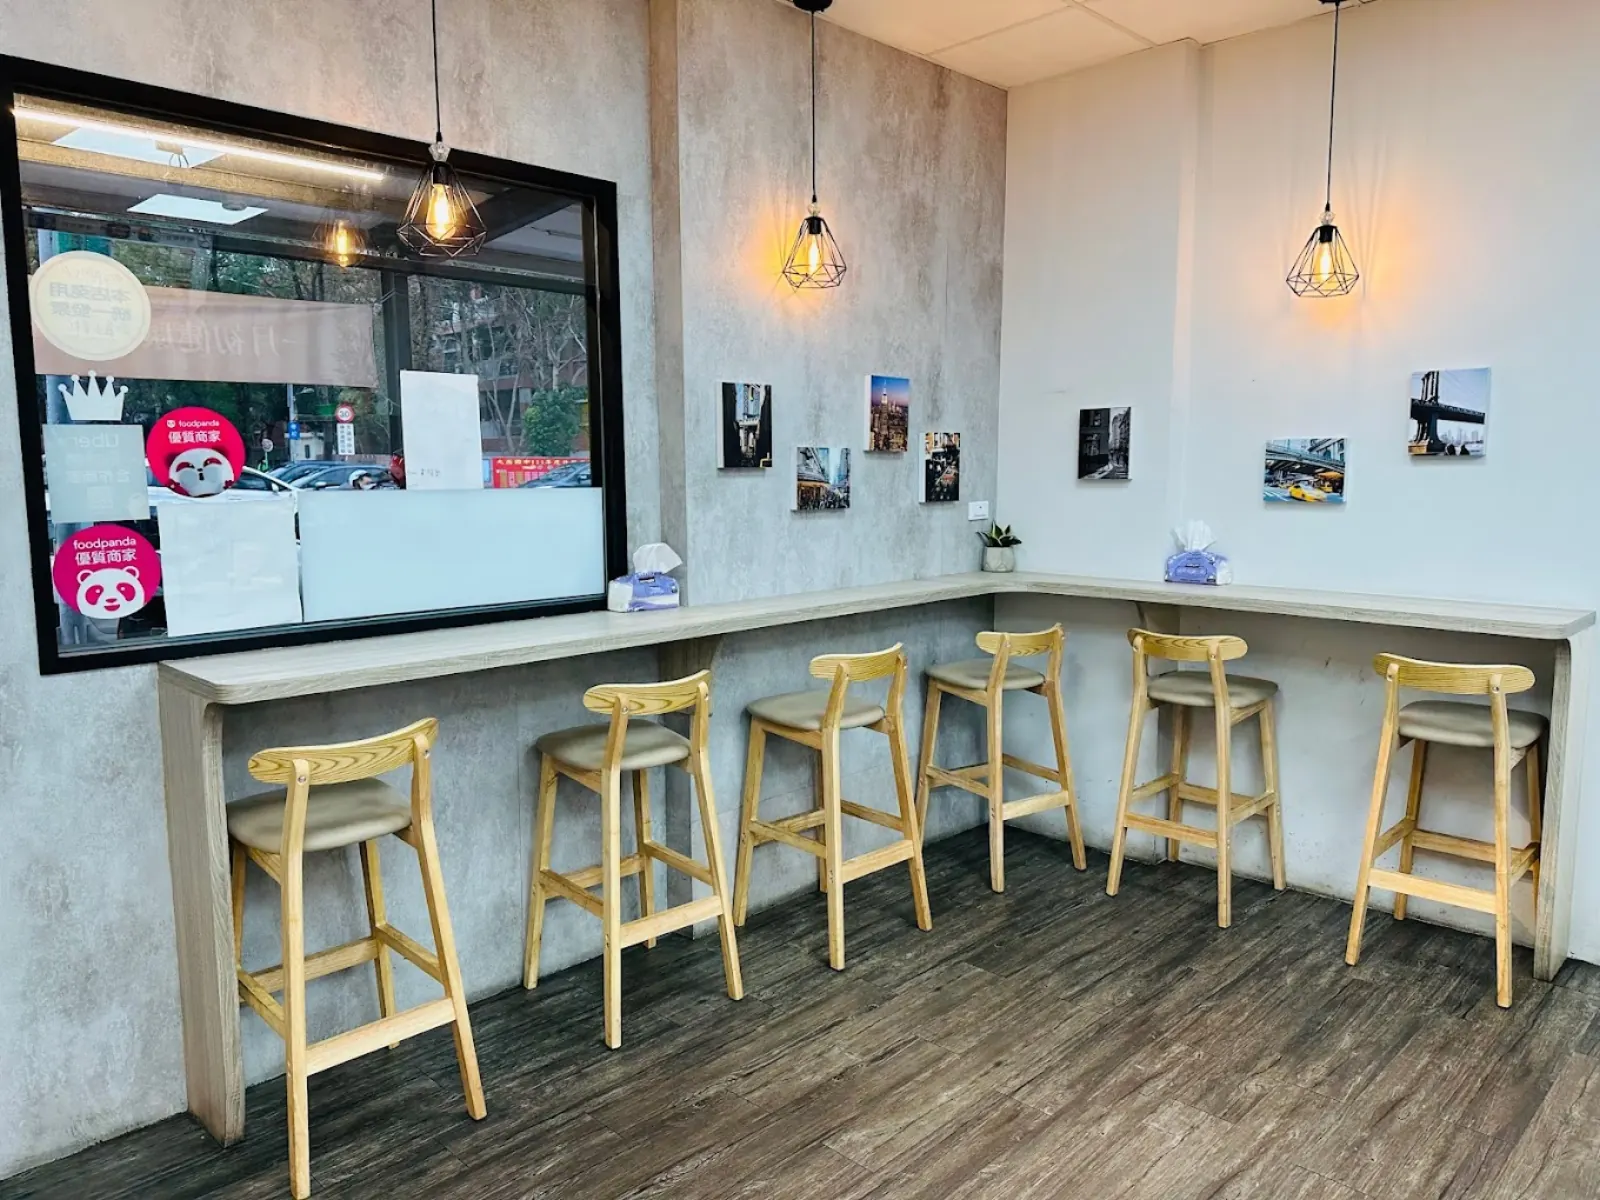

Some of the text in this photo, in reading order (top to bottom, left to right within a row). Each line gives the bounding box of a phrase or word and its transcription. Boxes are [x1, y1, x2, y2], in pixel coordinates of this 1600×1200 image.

[178, 419, 220, 428] foodpanda
[168, 430, 221, 444] 優質商家
[73, 536, 136, 550] foodpanda
[75, 548, 137, 567] 優質商家
